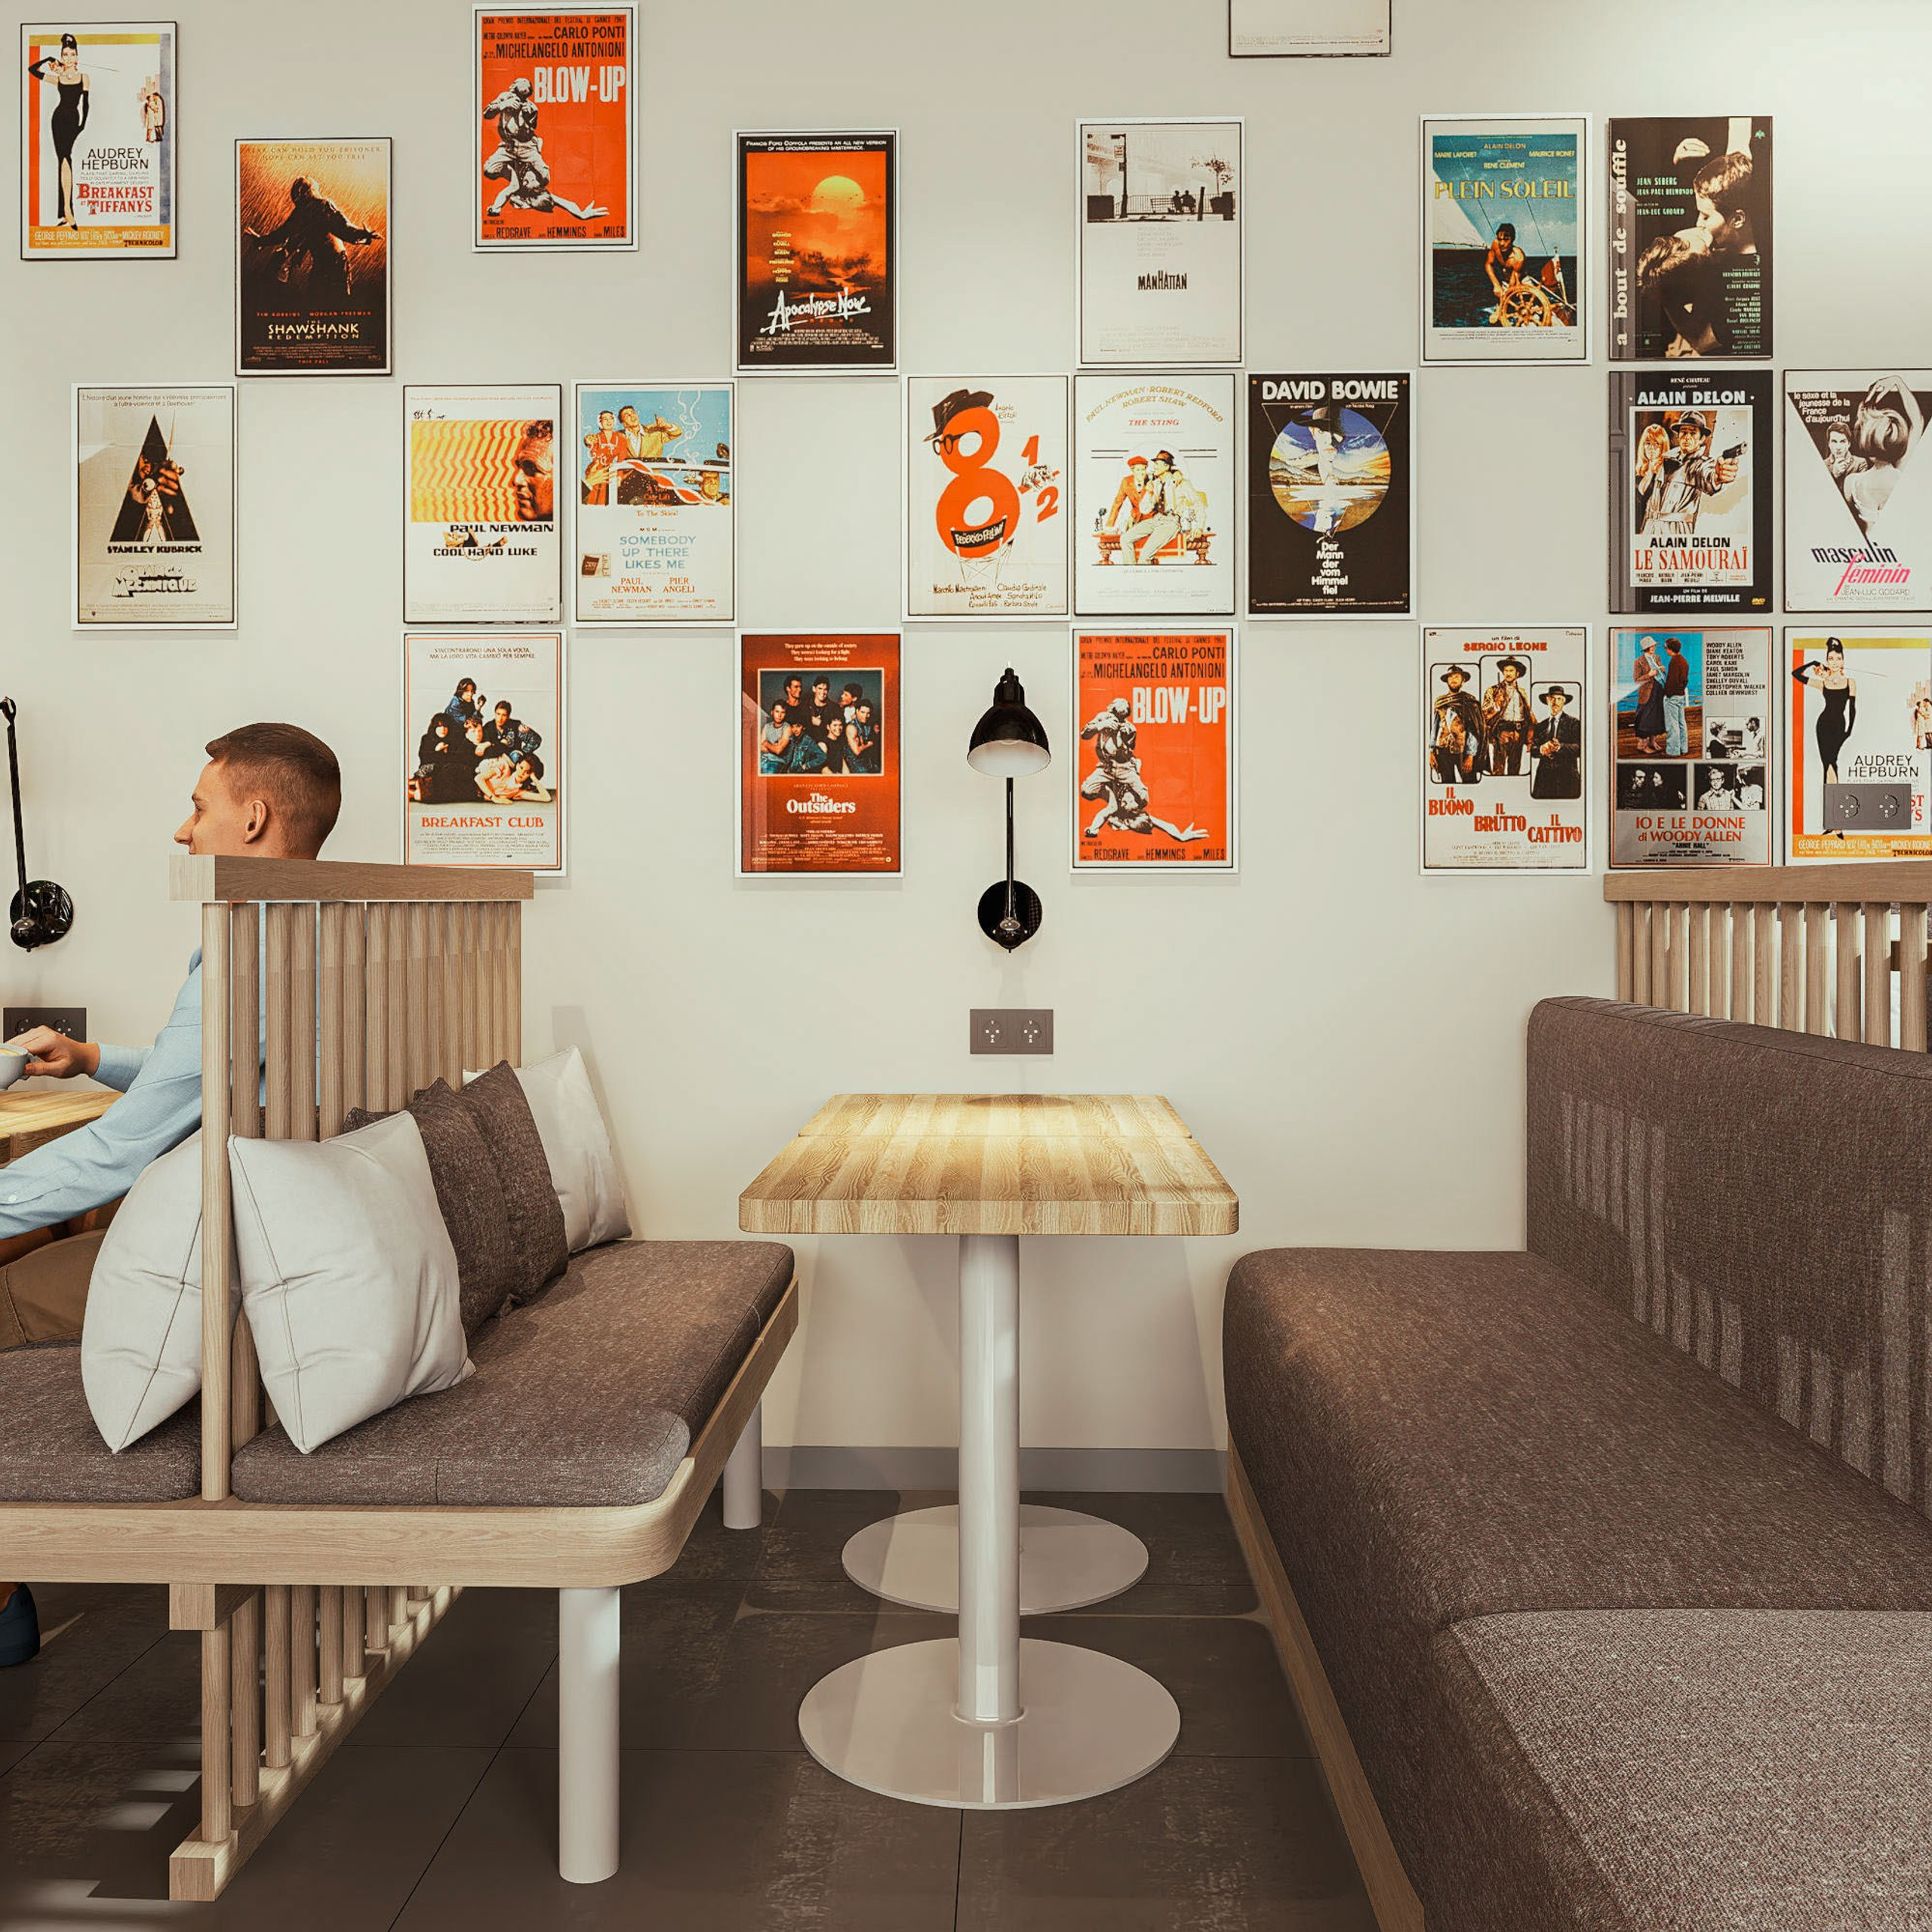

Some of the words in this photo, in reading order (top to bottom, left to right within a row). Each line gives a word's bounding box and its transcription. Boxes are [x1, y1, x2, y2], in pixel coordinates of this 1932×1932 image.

[554, 26, 589, 38] CARLO
[592, 26, 624, 38] PONTI
[497, 42, 568, 59] MICHELANGELO
[571, 42, 624, 58] ANTONIONI
[534, 66, 626, 103] BLOW-UP
[88, 148, 143, 158] AUDREY
[82, 160, 148, 169] HEPBURN
[76, 183, 154, 198] BREAKFAST
[1435, 180, 1495, 199] PLEIN
[1500, 180, 1575, 198] SOLEIL
[87, 198, 152, 214] TIFFANY'S
[497, 227, 531, 238] REDGRAVE
[547, 226, 586, 238] HEMMINGS
[604, 226, 625, 237] MILES
[1613, 226, 1626, 254] de
[1138, 270, 1187, 291] MANHATTAN
[1614, 268, 1627, 319] bout
[768, 290, 836, 334] Apocalypse
[838, 287, 866, 319] Now
[268, 323, 359, 334] SHAWSHANK
[1617, 333, 1627, 346] a
[1262, 380, 1325, 400] DAVID
[1332, 380, 1398, 399] BOWIE
[1122, 396, 1157, 409] ROBERT
[1159, 396, 1187, 408] SHAW
[1638, 391, 1686, 405] ALAIN
[1692, 391, 1746, 404] DELON
[1799, 399, 1831, 408] jeunesse
[1149, 386, 1185, 397] ROBERT
[1186, 392, 1223, 423] REDFORD
[936, 407, 1020, 558] 8
[620, 536, 696, 545] SOMEBODY
[1651, 537, 1687, 548] ALAIN
[1692, 537, 1730, 548] DELON
[107, 545, 154, 553] STANLEY
[433, 548, 465, 556] COOL
[623, 548, 640, 557] UP
[646, 548, 689, 557] THERE
[1321, 543, 1339, 551] Der
[1811, 540, 1897, 563] masculin
[1316, 550, 1344, 559] Mann
[1635, 549, 1653, 570] LE
[1659, 546, 1748, 570] SAMOURAÏ
[626, 560, 661, 569] LIKES
[667, 560, 686, 569] ME
[1322, 560, 1340, 568] der
[1320, 568, 1340, 577] vom
[1311, 575, 1348, 586] Himmel
[1322, 586, 1337, 595] fiel
[1650, 595, 1701, 603] JEAN-PIERRE
[1703, 595, 1740, 603] MELVILLE
[1463, 642, 1506, 651] SERGIO
[1509, 642, 1547, 651] LEONE
[1153, 648, 1188, 659] CARLO
[1192, 647, 1224, 659] PONTI
[1094, 663, 1168, 678] MICHELANGELO
[1171, 663, 1224, 678] ANTONIONI
[1132, 687, 1226, 724] BLOW-UP
[1854, 755, 1912, 766] AUDREY
[1849, 767, 1918, 777] HEPBURN
[810, 792, 828, 802] The
[1446, 786, 1455, 798] IL
[786, 798, 856, 814] Outsiders
[1429, 799, 1474, 816] BUONO
[1495, 803, 1505, 815] IL
[422, 817, 503, 827] BREAKFAST
[508, 817, 543, 827] CLUB
[1474, 815, 1527, 832] BRUTTO
[1551, 814, 1561, 826] IL
[1636, 817, 1652, 829] IO
[1657, 817, 1664, 829] E
[1672, 817, 1686, 829] LE
[1693, 817, 1746, 829] DONNE
[1527, 826, 1583, 843] CATTIVO
[1638, 832, 1647, 841] di
[1651, 831, 1701, 841] WOODY
[1704, 831, 1741, 841] ALLEN
[1094, 849, 1129, 860] REDGRAVE
[1146, 848, 1186, 860] HEMMINGS
[1204, 848, 1225, 859] MILES
